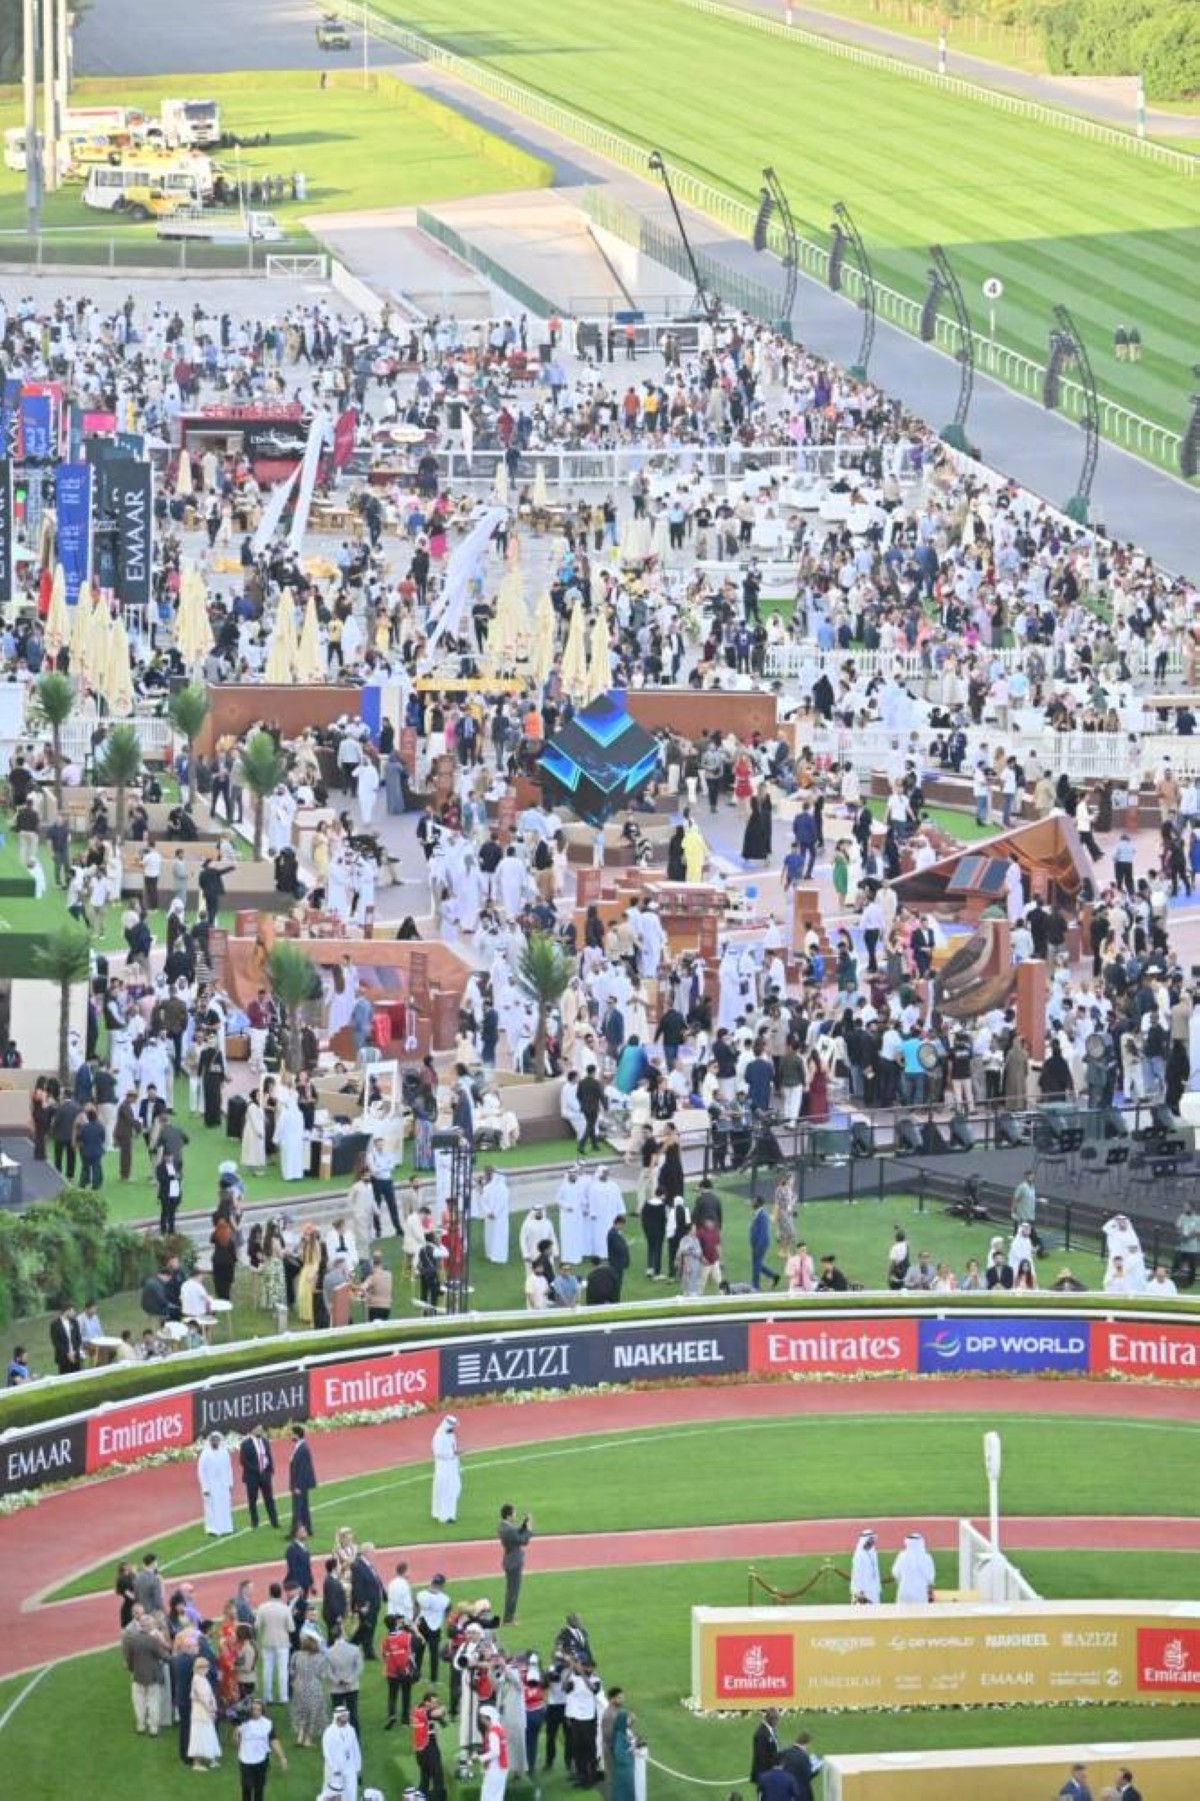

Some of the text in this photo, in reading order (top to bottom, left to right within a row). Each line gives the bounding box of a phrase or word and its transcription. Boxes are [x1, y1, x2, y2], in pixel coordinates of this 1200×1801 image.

[988, 281, 997, 294] 4
[125, 488, 144, 581] EMAAR
[614, 1339, 725, 1368] NAKHEEL
[768, 1332, 901, 1363] Emirates
[966, 1337, 1085, 1353] DP WORLD
[1108, 1334, 1196, 1366] Emira
[481, 1344, 571, 1383] AZIZI
[324, 1367, 427, 1408] Emirates
[202, 1385, 304, 1428] JUMEIRAH
[99, 1411, 183, 1455] Emirates
[8, 1438, 72, 1480] EMAAR
[724, 1674, 787, 1690] Emirates
